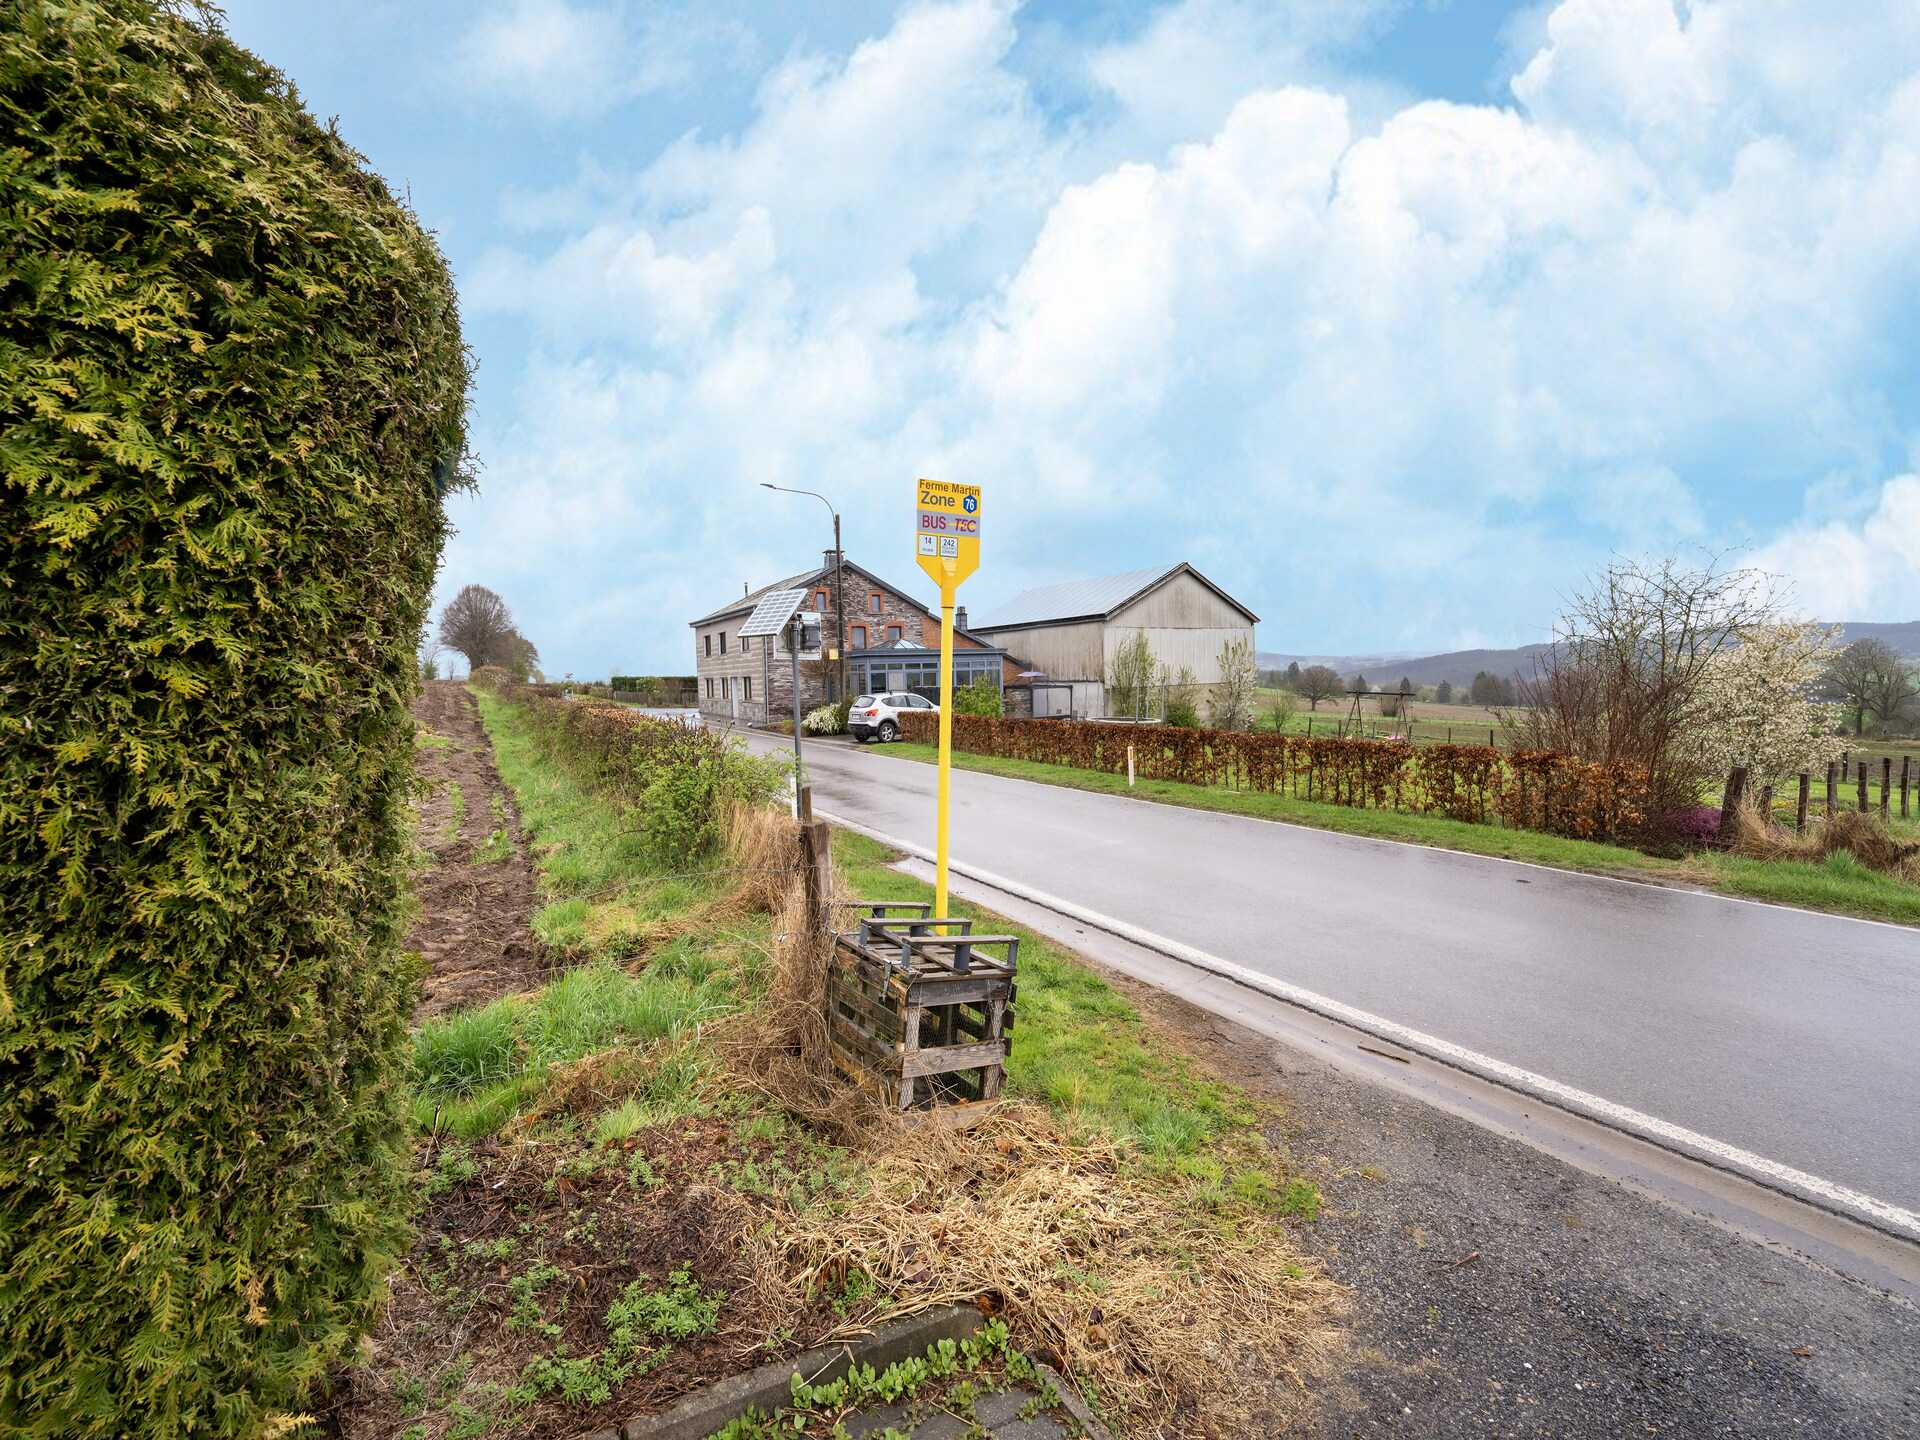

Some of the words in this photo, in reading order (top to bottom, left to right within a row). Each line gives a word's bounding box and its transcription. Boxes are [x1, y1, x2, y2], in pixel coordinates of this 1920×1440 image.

[920, 479, 948, 492] Ferme
[952, 484, 980, 496] Martin
[921, 491, 955, 506] Zone
[965, 499, 974, 510] 76
[922, 515, 946, 529] BUS
[955, 519, 976, 532] TEC
[924, 537, 932, 545] 14
[943, 539, 955, 547] 242
